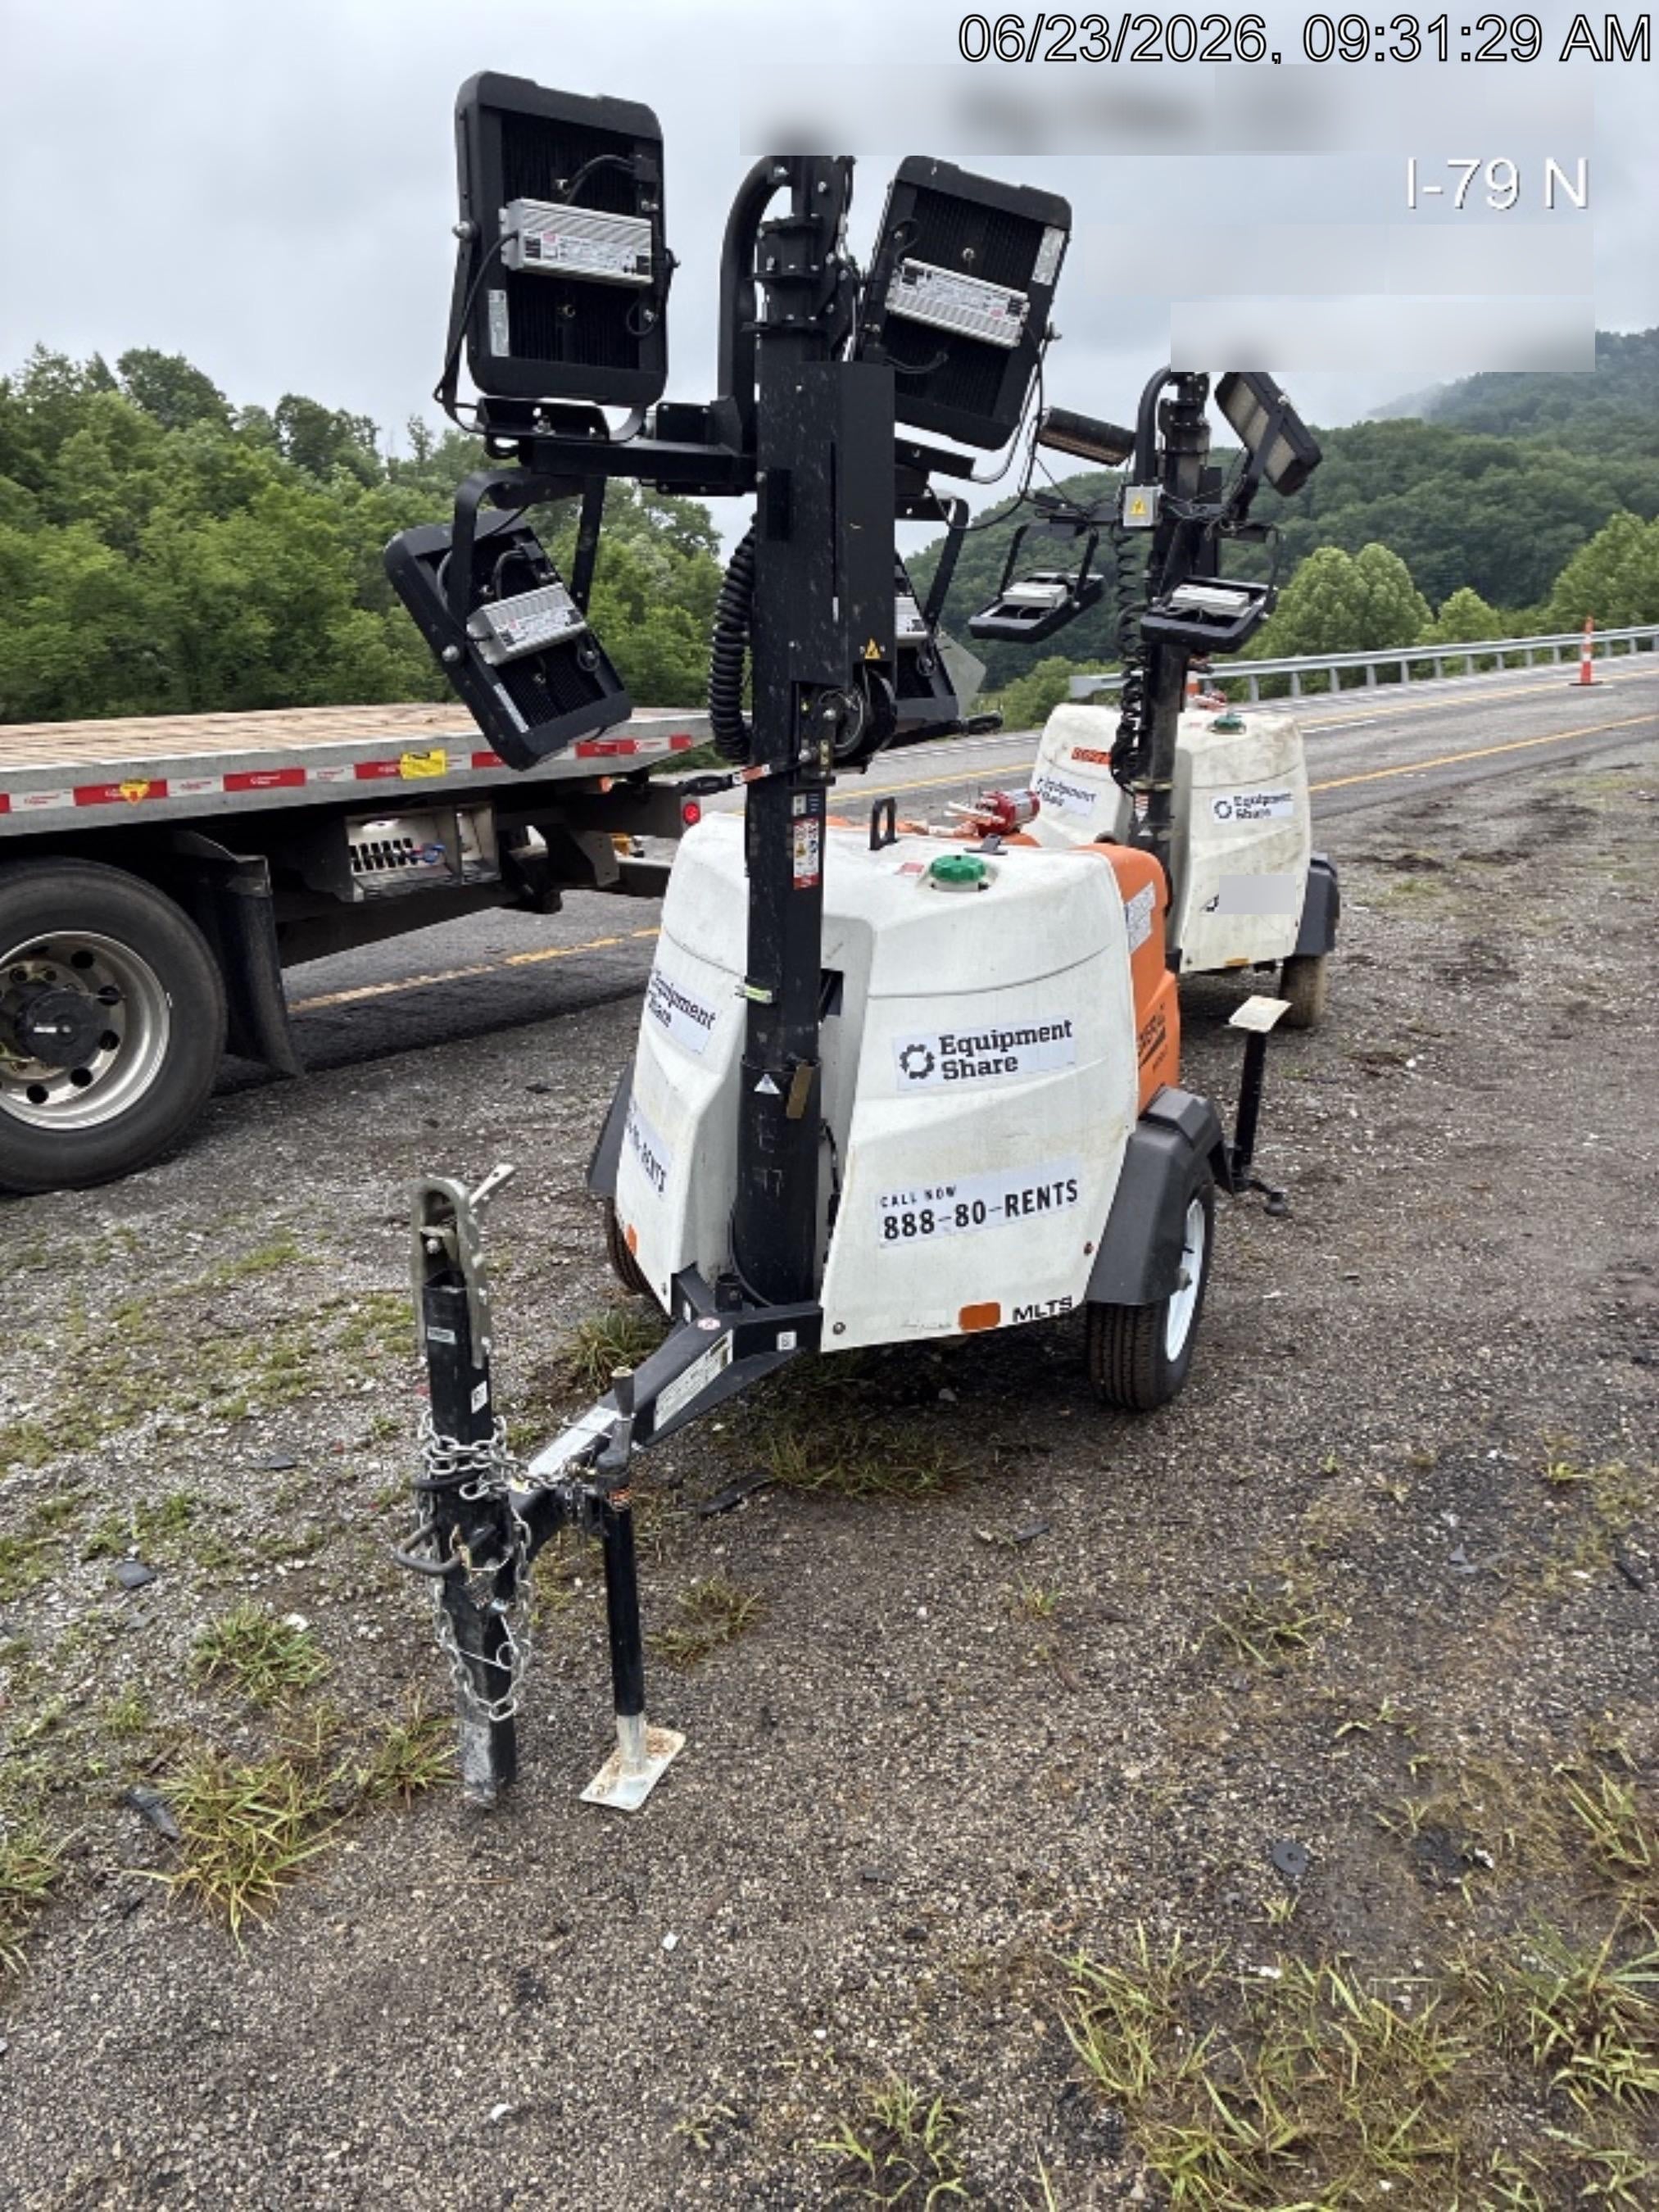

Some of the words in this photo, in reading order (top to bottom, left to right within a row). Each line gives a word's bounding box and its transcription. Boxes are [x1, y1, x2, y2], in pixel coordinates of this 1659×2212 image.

[939, 1019, 1072, 1057] Equipment
[941, 1056, 1018, 1080] Share
[880, 1192, 917, 1208] CALL
[924, 1185, 957, 1201] NOW
[883, 1179, 1078, 1240] 888-80-RENTS
[1013, 1295, 1072, 1322] MLTS
